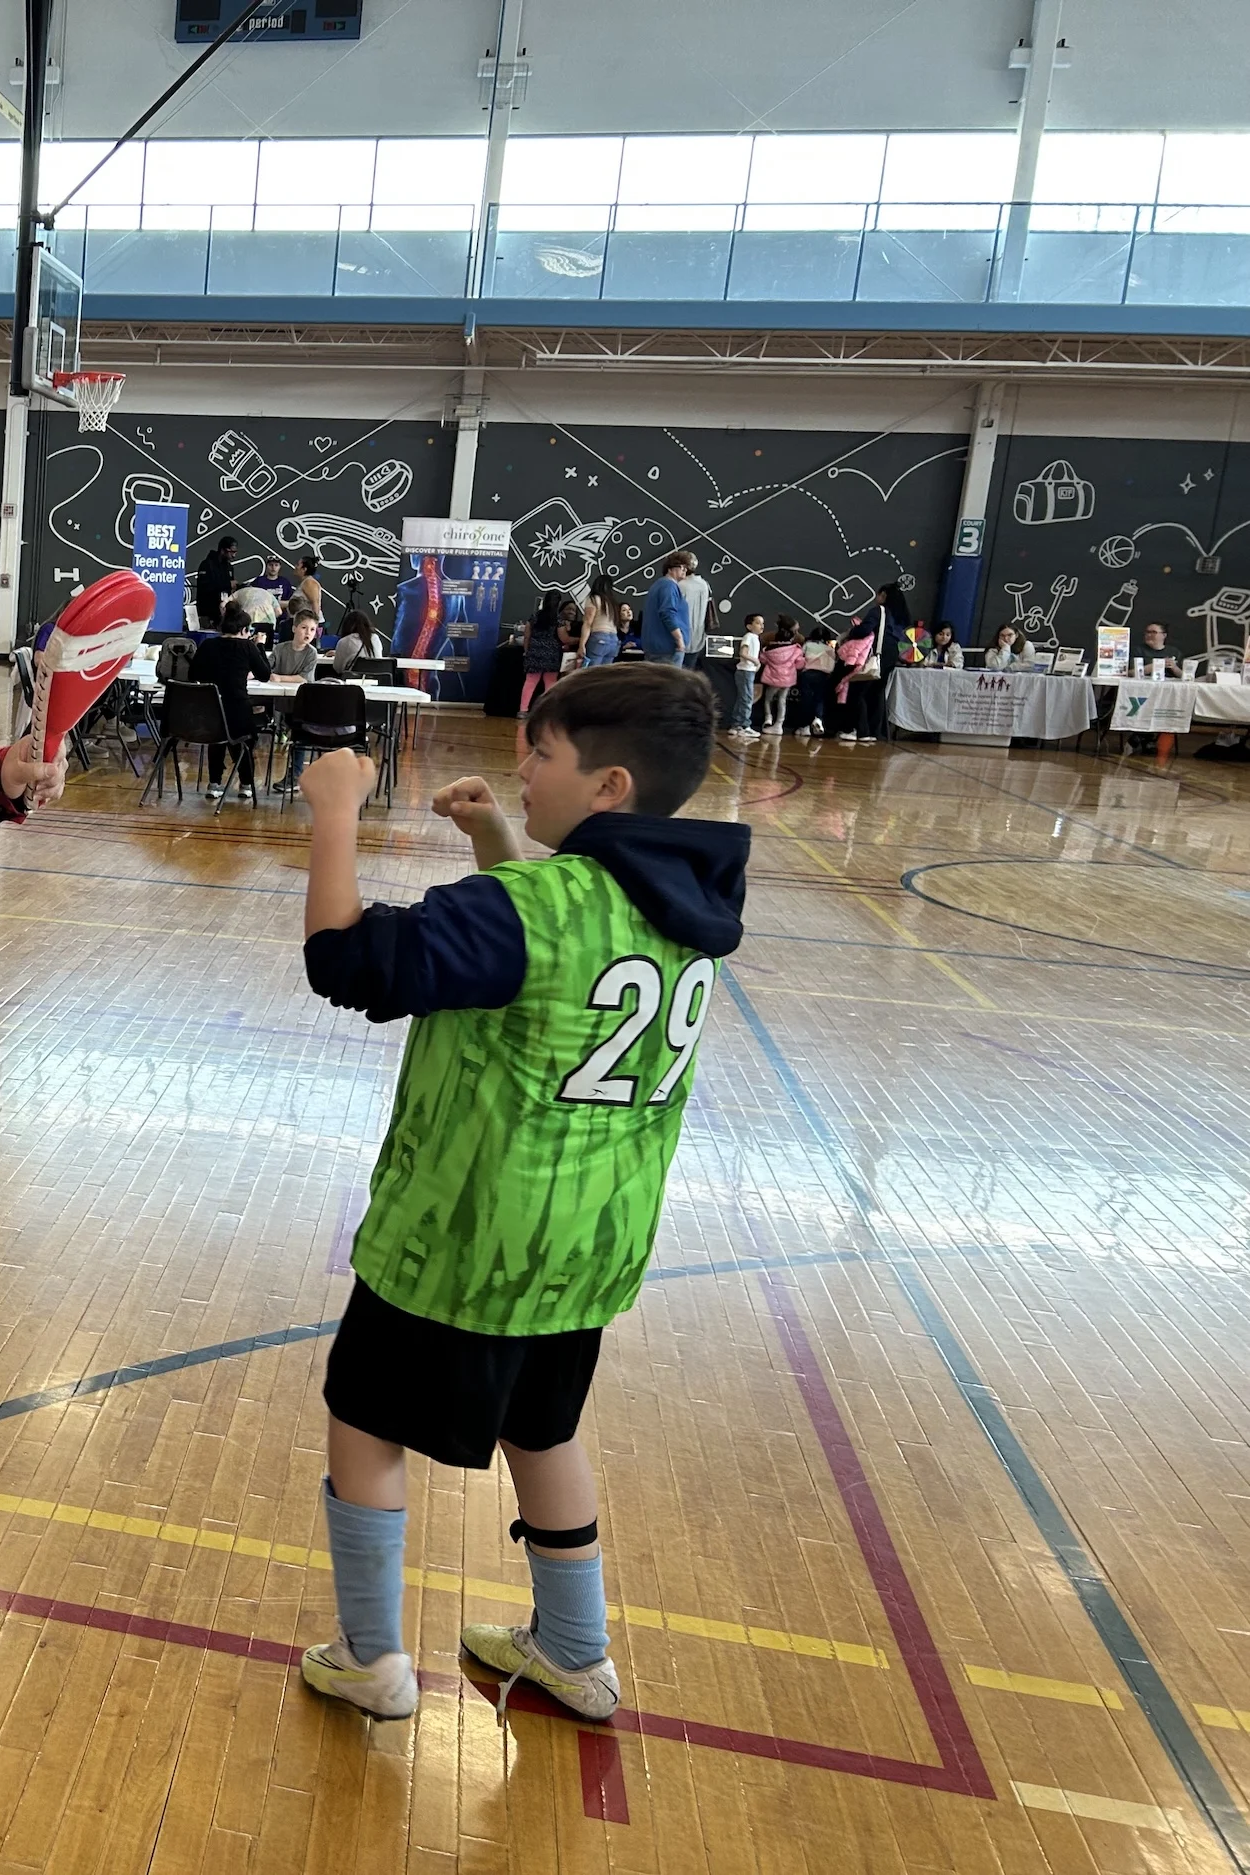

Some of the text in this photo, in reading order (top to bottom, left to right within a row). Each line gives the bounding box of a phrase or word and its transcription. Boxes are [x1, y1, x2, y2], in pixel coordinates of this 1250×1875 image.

[248, 15, 285, 31] period
[146, 523, 176, 539] BEST
[148, 536, 173, 551] BUY
[958, 527, 980, 553] 3
[134, 553, 185, 569] Teen Tech
[470, 549, 504, 557] POTENTIAL
[141, 569, 177, 583] Center
[553, 954, 716, 1107] 29
